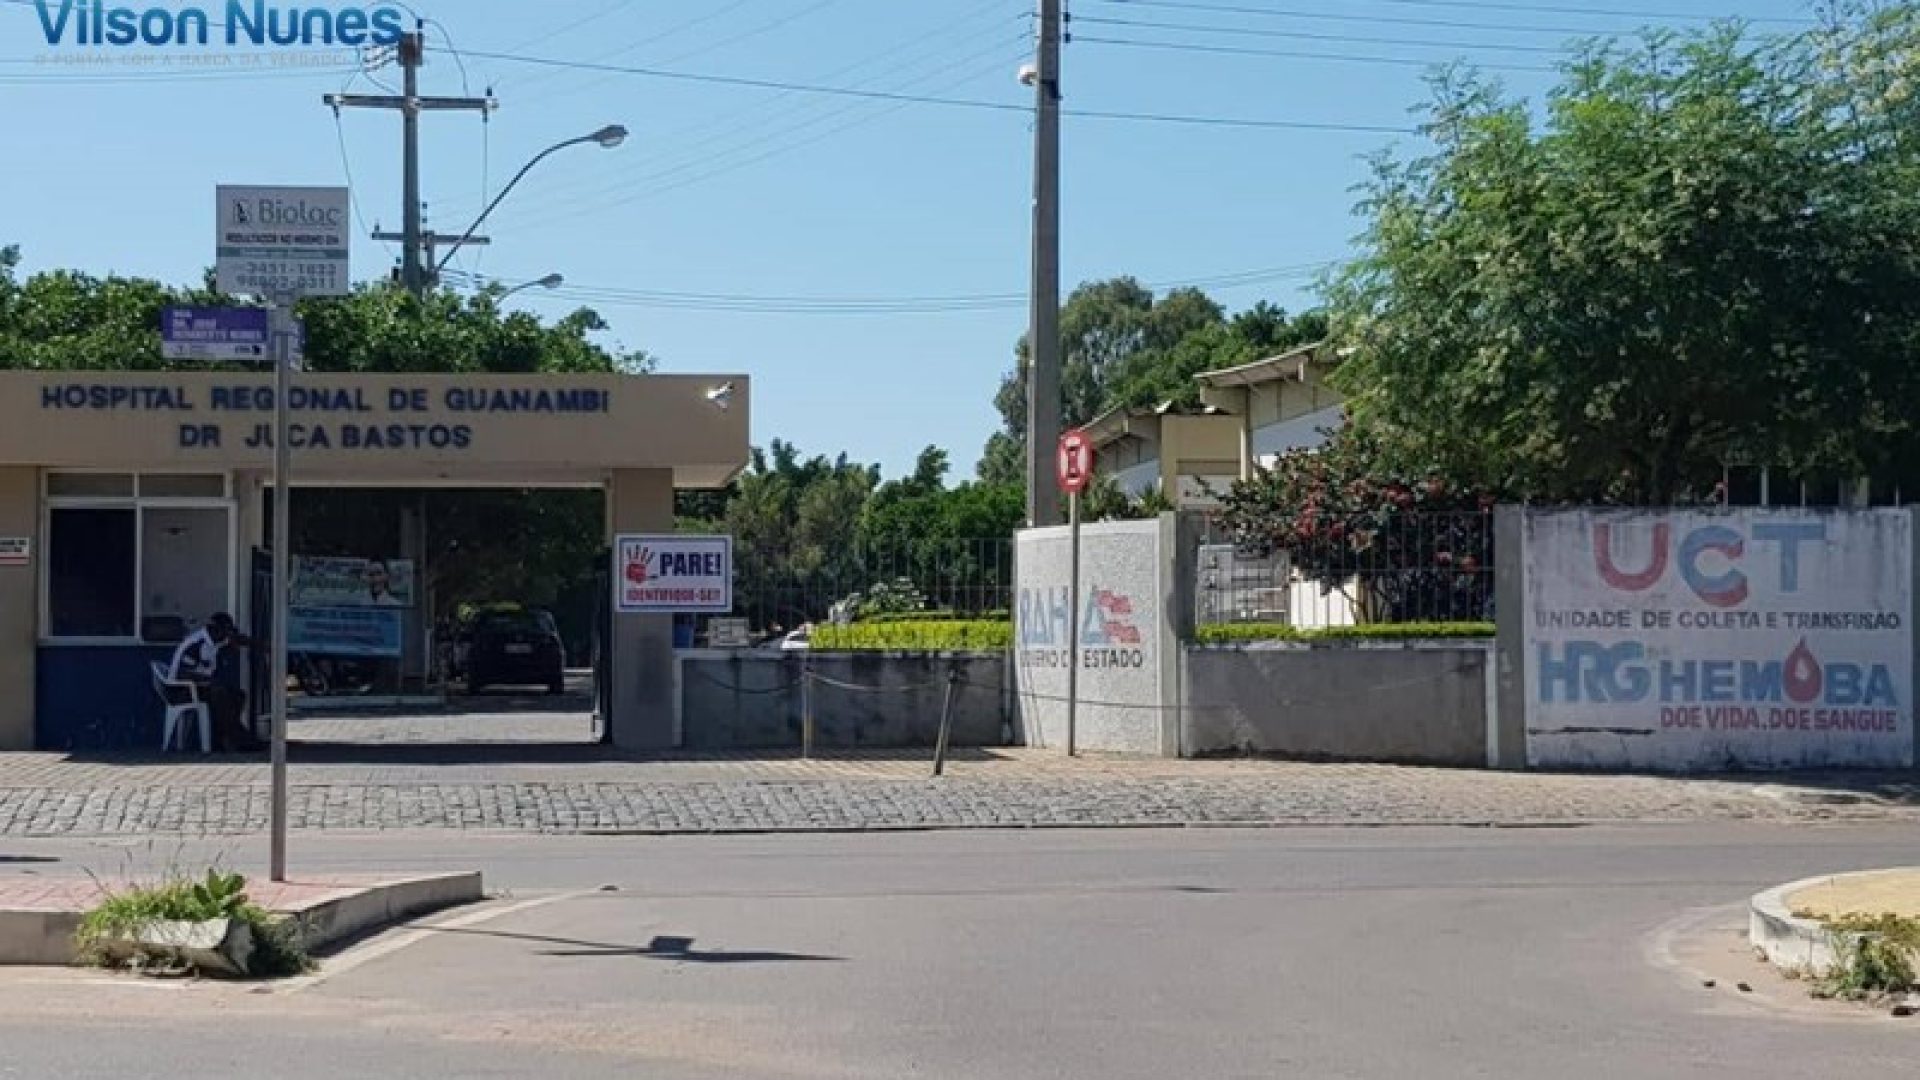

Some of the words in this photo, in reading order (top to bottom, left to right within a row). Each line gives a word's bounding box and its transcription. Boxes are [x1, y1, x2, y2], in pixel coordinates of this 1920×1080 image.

[42, 385, 193, 409] HOSPITAL
[211, 386, 371, 410] REGONAL
[388, 389, 429, 411] DE
[445, 388, 609, 412] GUANAMBI
[180, 424, 220, 447] DR
[340, 424, 471, 448] BASTOS
[660, 552, 721, 577] PARE!
[1592, 521, 1826, 607] UCT
[1536, 611, 1633, 627] UNIDADE
[1641, 611, 1671, 629] DE
[1766, 612, 1777, 629] E
[1084, 648, 1143, 668] ESTADO
[1537, 640, 1652, 703] HRG
[1661, 707, 1702, 728] DOE
[1814, 709, 1897, 732] SANGUE
